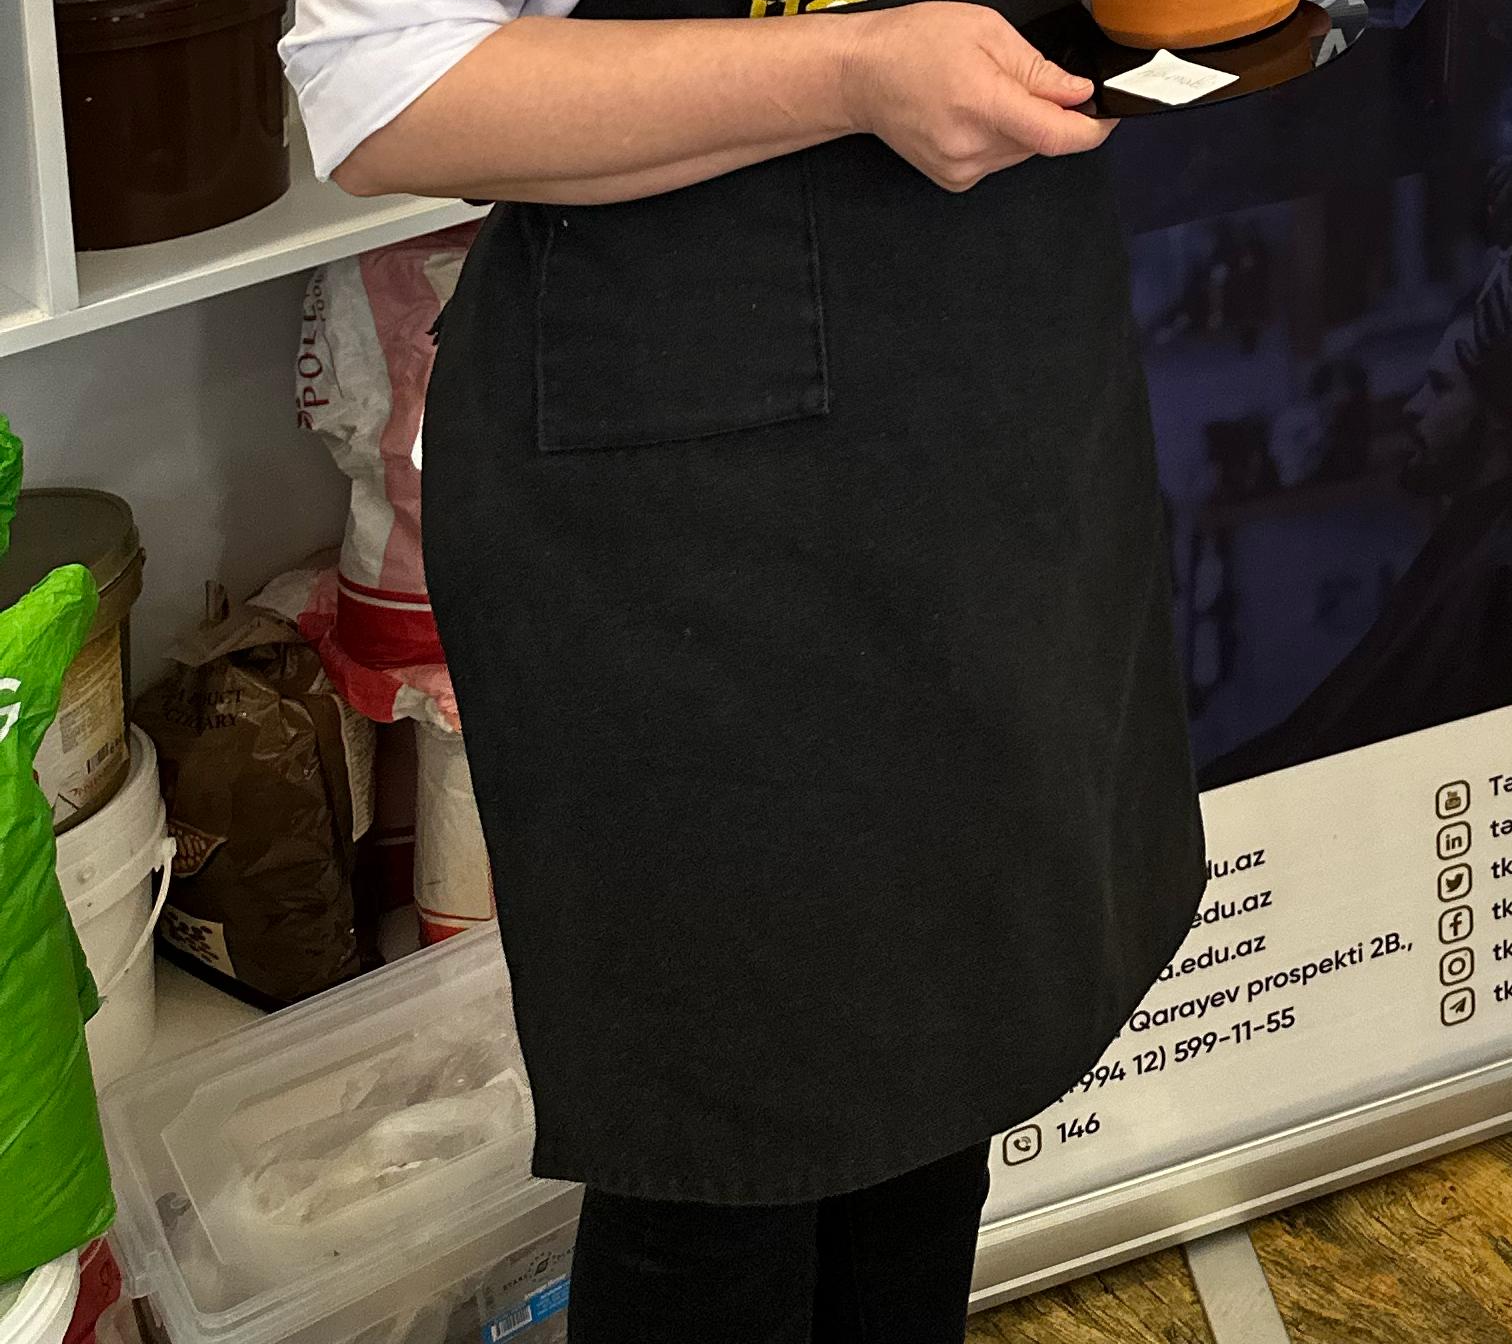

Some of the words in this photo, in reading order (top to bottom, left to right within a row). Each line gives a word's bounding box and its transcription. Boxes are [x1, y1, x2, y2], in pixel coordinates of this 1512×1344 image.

[1128, 985, 1240, 1035] Qarayev
[1246, 946, 1364, 1003] prospekti
[1369, 931, 1414, 961] 2B.,
[1132, 1045, 1167, 1077] 12)
[1174, 1006, 1297, 1065] 599-11-55
[1056, 1112, 1101, 1145] 146
